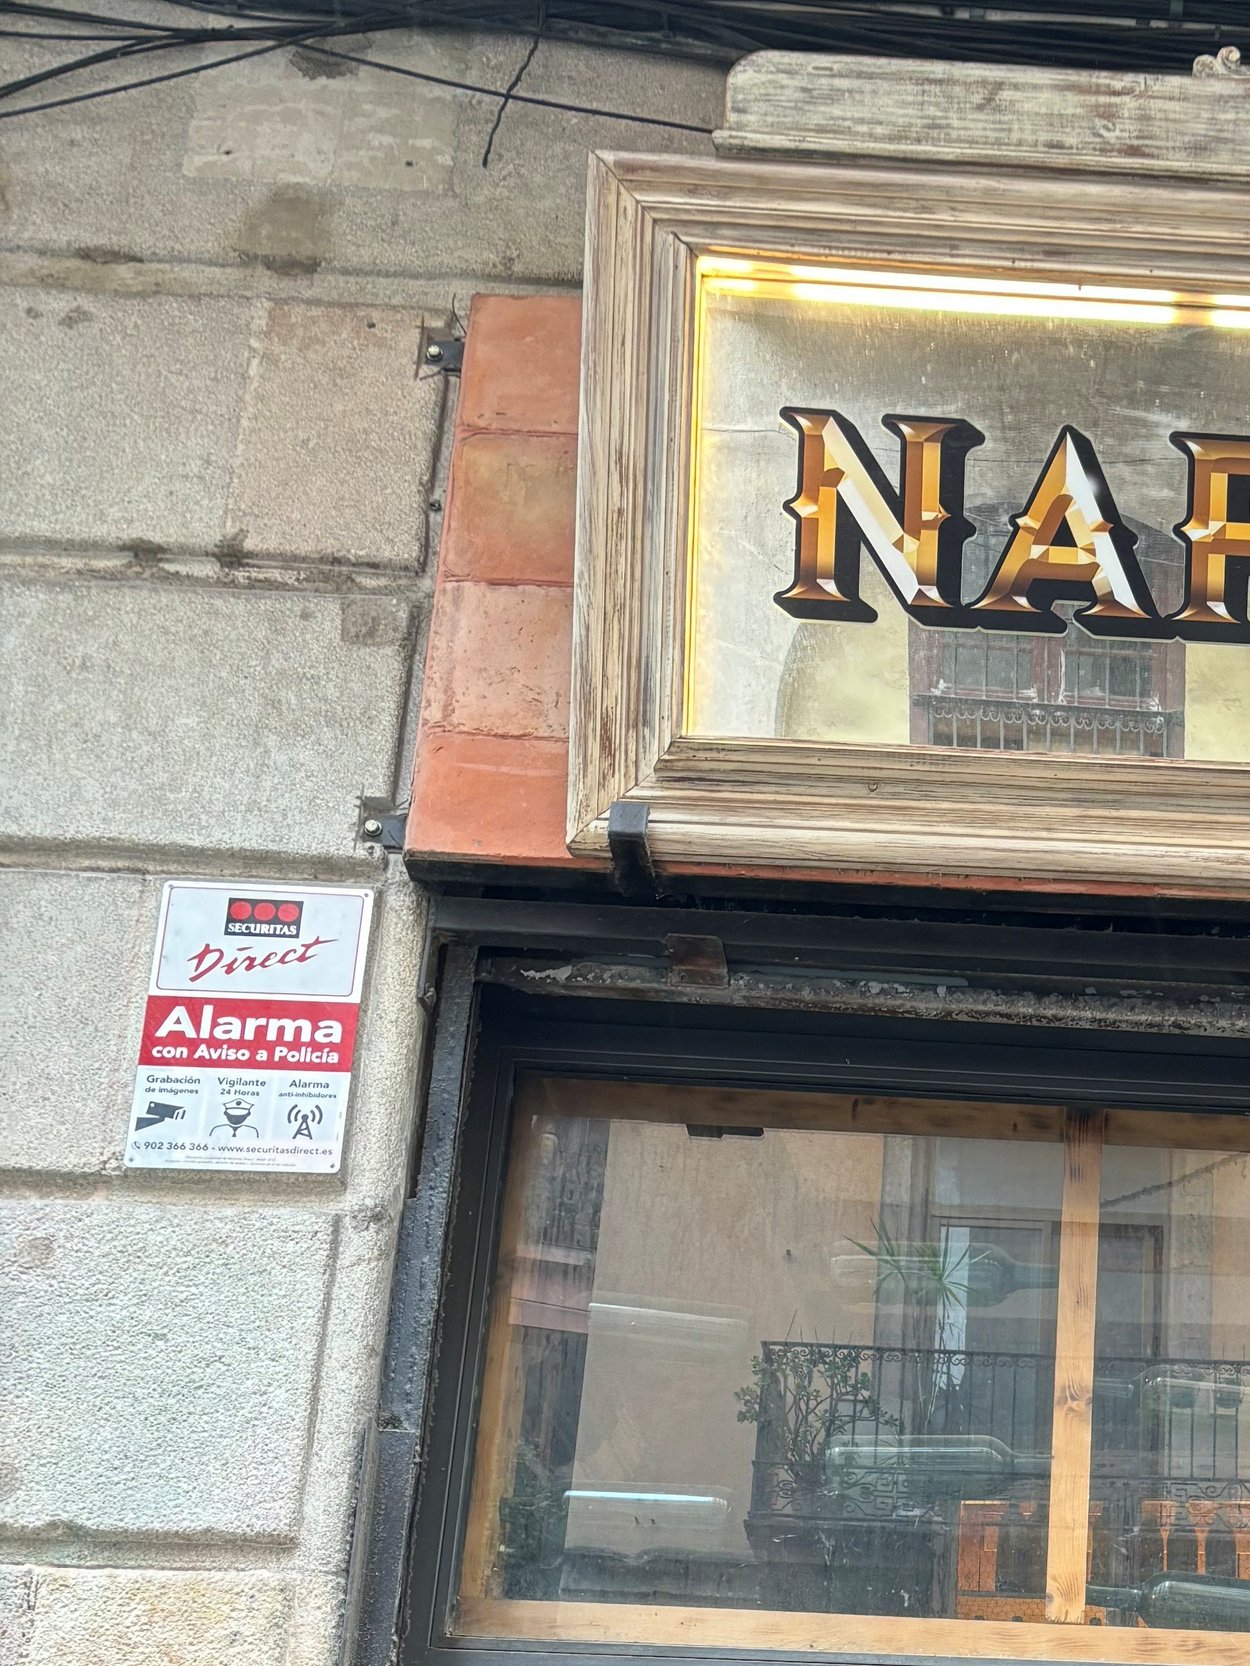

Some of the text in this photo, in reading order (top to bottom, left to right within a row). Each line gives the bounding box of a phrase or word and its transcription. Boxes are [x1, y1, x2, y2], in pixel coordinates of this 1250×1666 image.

[228, 922, 297, 935] SECURITAS
[187, 936, 339, 982] Direct
[155, 1004, 343, 1044] Alarma
[151, 1044, 339, 1064] con Aviso a Policía
[146, 1074, 201, 1085] Grabación
[217, 1077, 267, 1088] Vigilante
[289, 1080, 329, 1089] Alarma
[144, 1086, 199, 1095] de imágenes
[234, 1089, 260, 1097] Horas
[278, 1091, 337, 1099] anti-inhibidores
[143, 1141, 164, 1150] 902
[166, 1142, 187, 1151] 366
[189, 1142, 209, 1151] 366
[218, 1144, 333, 1156] www.securitasdirect.es
